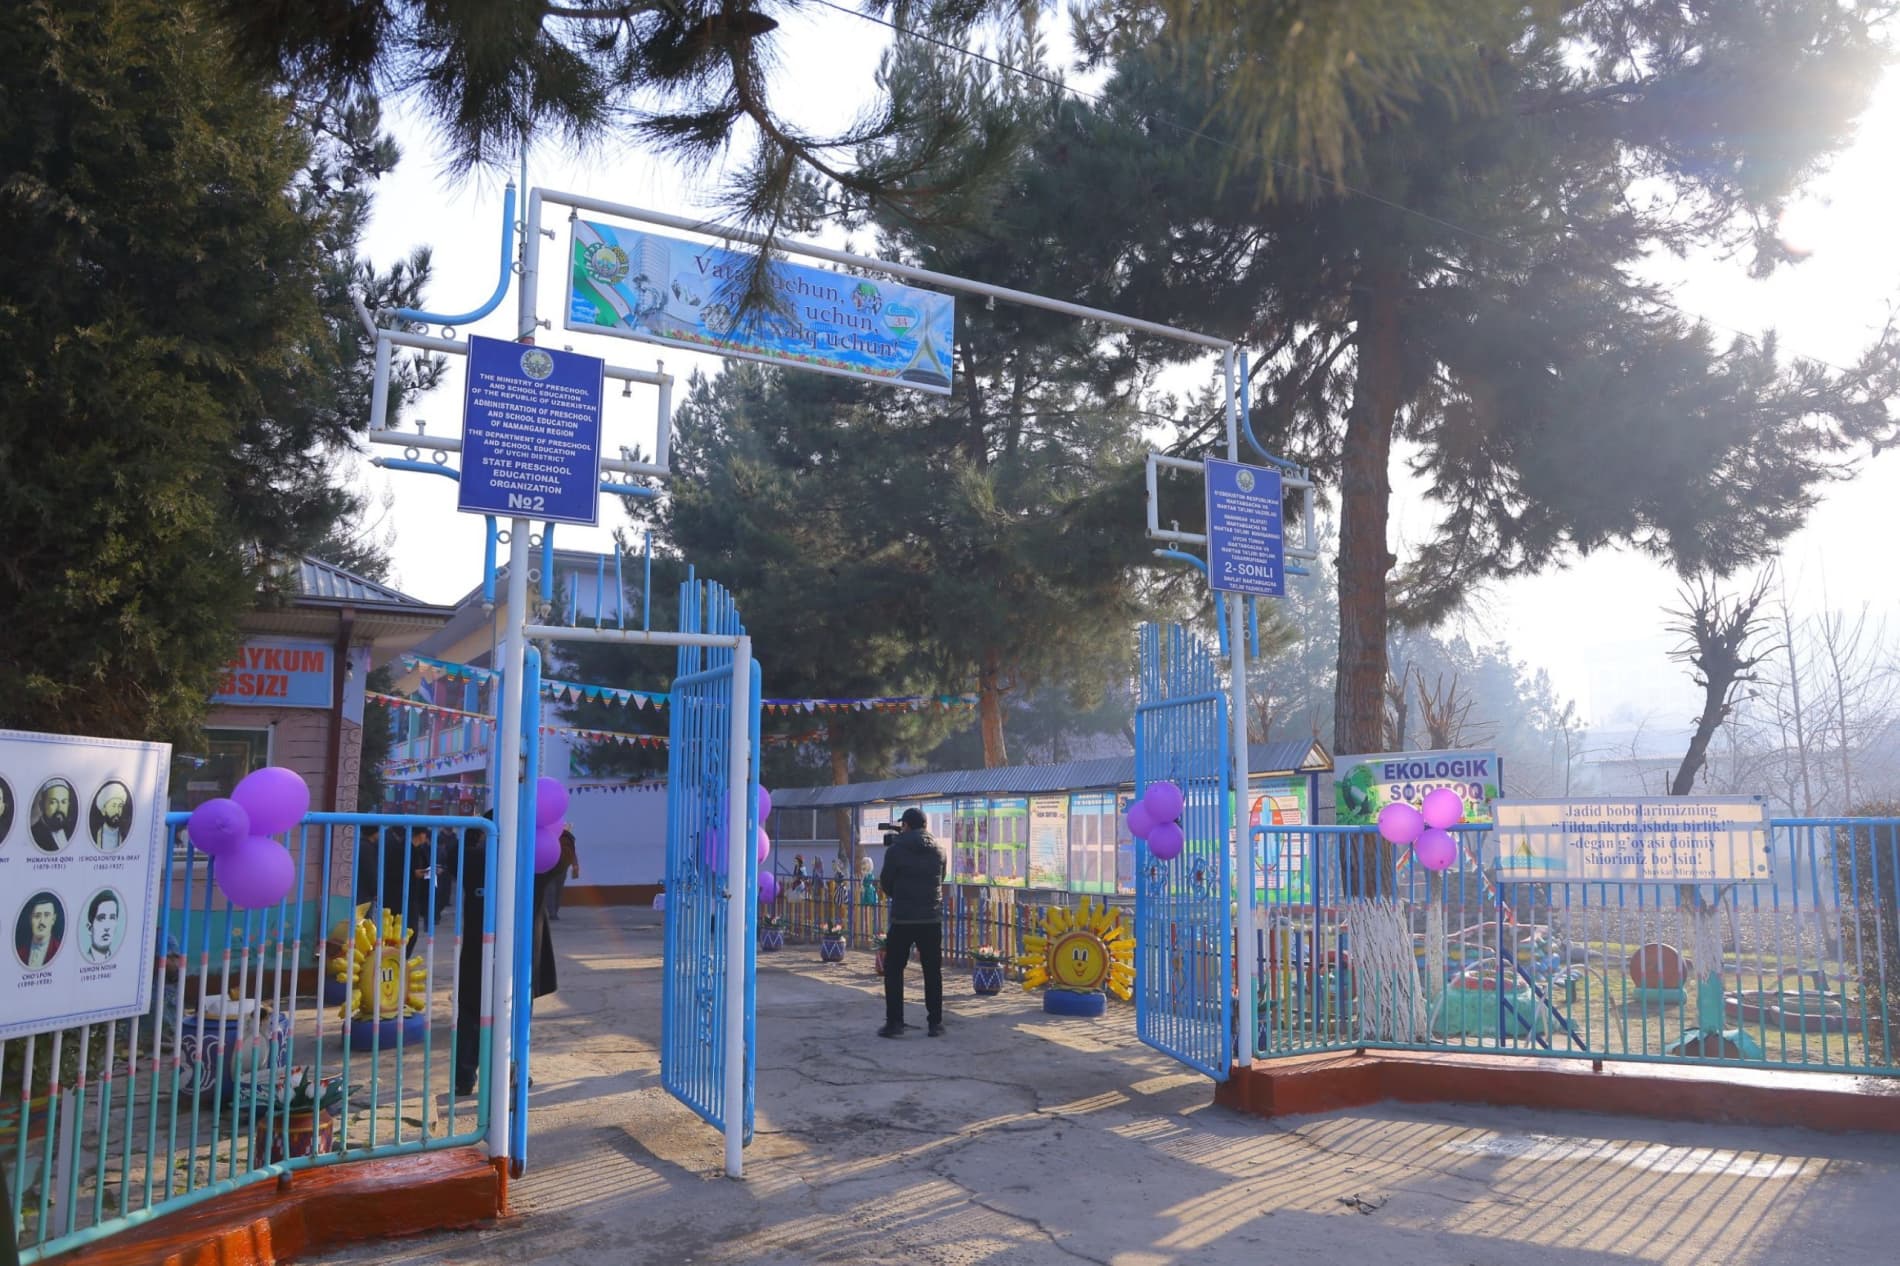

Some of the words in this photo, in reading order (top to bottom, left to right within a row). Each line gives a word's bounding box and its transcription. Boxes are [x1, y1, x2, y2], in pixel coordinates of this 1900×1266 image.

[694, 255, 747, 282] Vata
[804, 306, 879, 335] uchun,
[827, 332, 898, 358] uchun!
[497, 375, 532, 386] MINISTRY
[546, 384, 589, 396] PRESCHOOL
[508, 385, 537, 395] SCHOOL
[540, 390, 581, 402] EDUCATION
[474, 398, 536, 414] ADMINISTRATION
[550, 410, 592, 422] PRESCHOOL
[501, 392, 537, 402] REPUBLIC
[551, 400, 596, 412] UZBEKISTAN
[488, 410, 504, 418] AND
[505, 412, 534, 423] SCHOOL
[537, 417, 578, 429] EDUCATION
[468, 428, 482, 436] THE
[485, 430, 534, 443] DEPARTMENT
[548, 439, 592, 450] PRESCHOOL
[502, 422, 544, 434] NAMANGAN
[546, 428, 574, 438] REGION
[501, 441, 532, 450] SCHOOL
[534, 445, 576, 456] EDUCATION
[506, 450, 529, 458] UYCHI
[531, 452, 565, 462] DISTRICT
[482, 457, 512, 468] STATE
[515, 461, 572, 476] PRESCHOOL
[493, 469, 560, 484] EDUCATIONAL
[490, 479, 562, 494] ORGANIZATION
[1225, 562, 1272, 578] 2-SONLI
[1384, 759, 1489, 780] EKOLOGIK
[1390, 782, 1484, 801] SO‘OQ
[1565, 804, 1602, 817] Jadid
[1606, 804, 1718, 819] bobolarimizning
[1669, 837, 1717, 852] doimiy
[1584, 853, 1648, 865] shiorimiz
